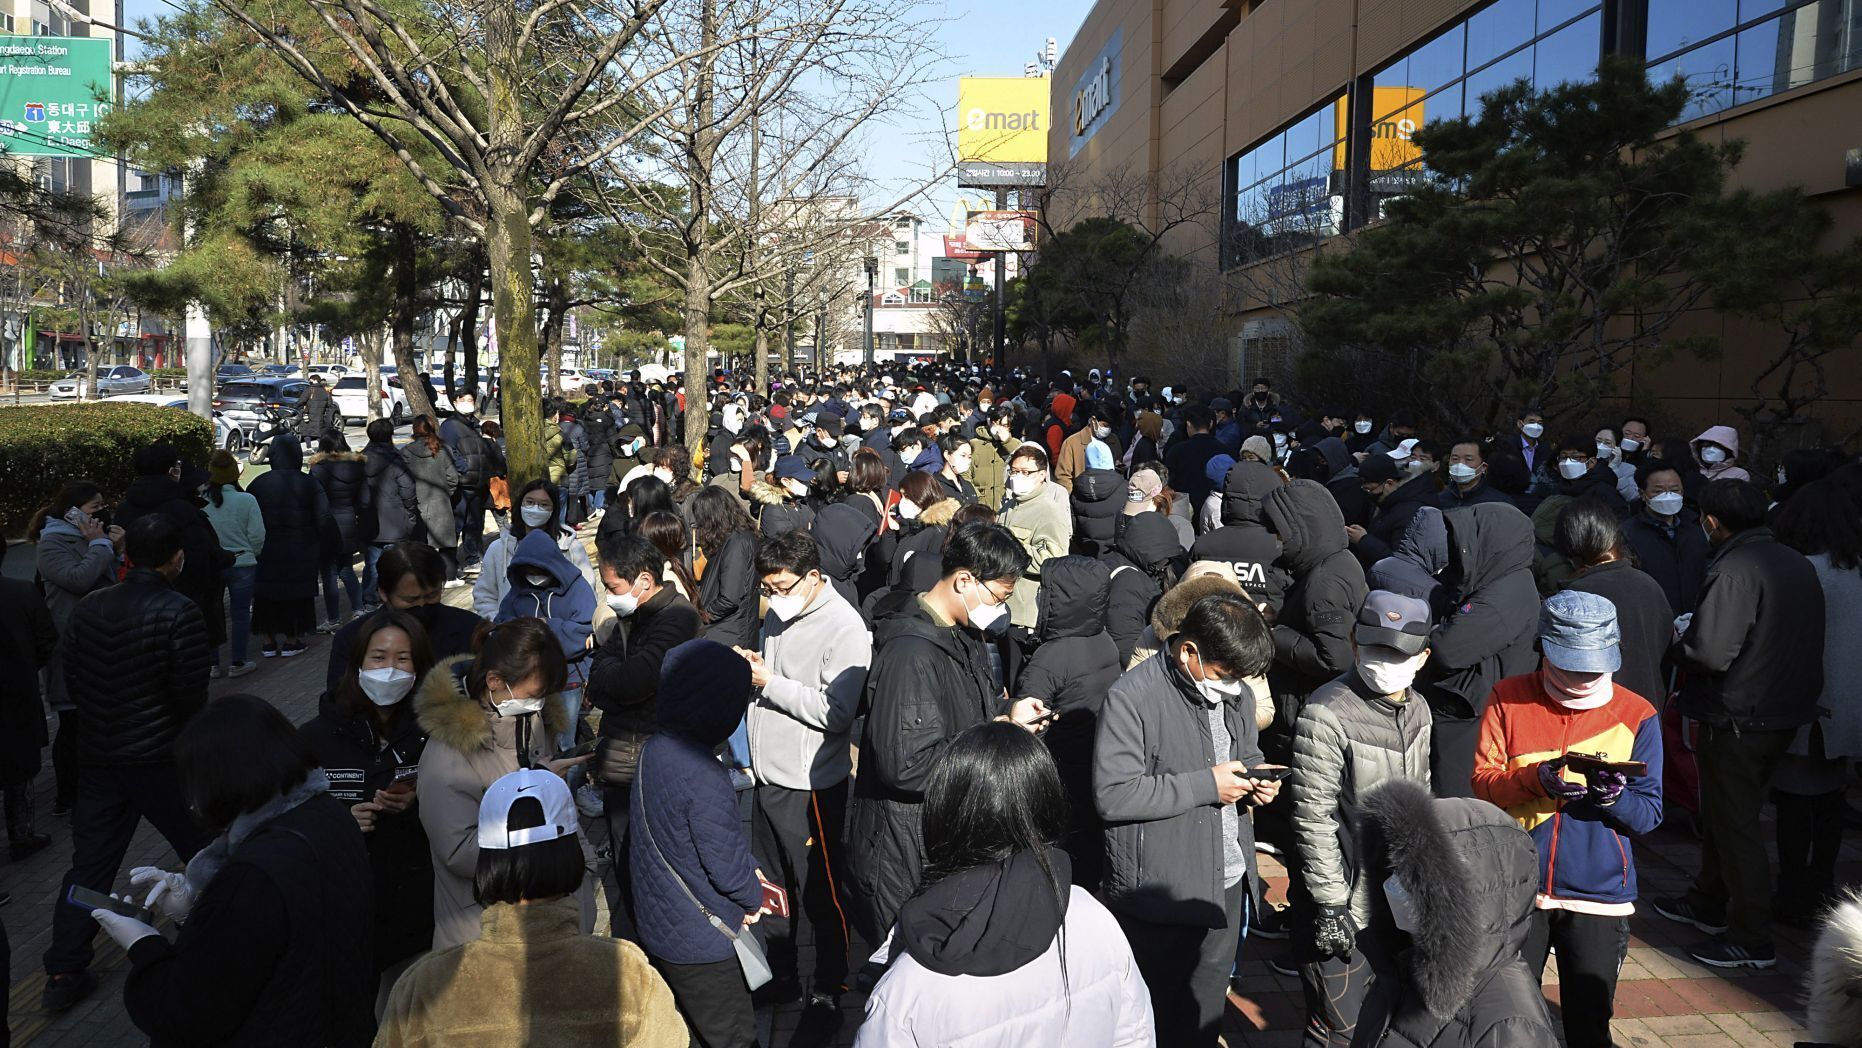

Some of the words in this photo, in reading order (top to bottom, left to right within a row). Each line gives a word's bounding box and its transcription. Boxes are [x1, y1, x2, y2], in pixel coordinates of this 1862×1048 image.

[37, 44, 68, 55] Station
[8, 64, 46, 77] Registration
[47, 65, 71, 76] Bureau
[1076, 56, 1111, 135] emart
[32, 109, 38, 121] 1
[46, 102, 89, 118] 동대구
[967, 107, 1040, 131] emart
[47, 120, 90, 134] 東大邱
